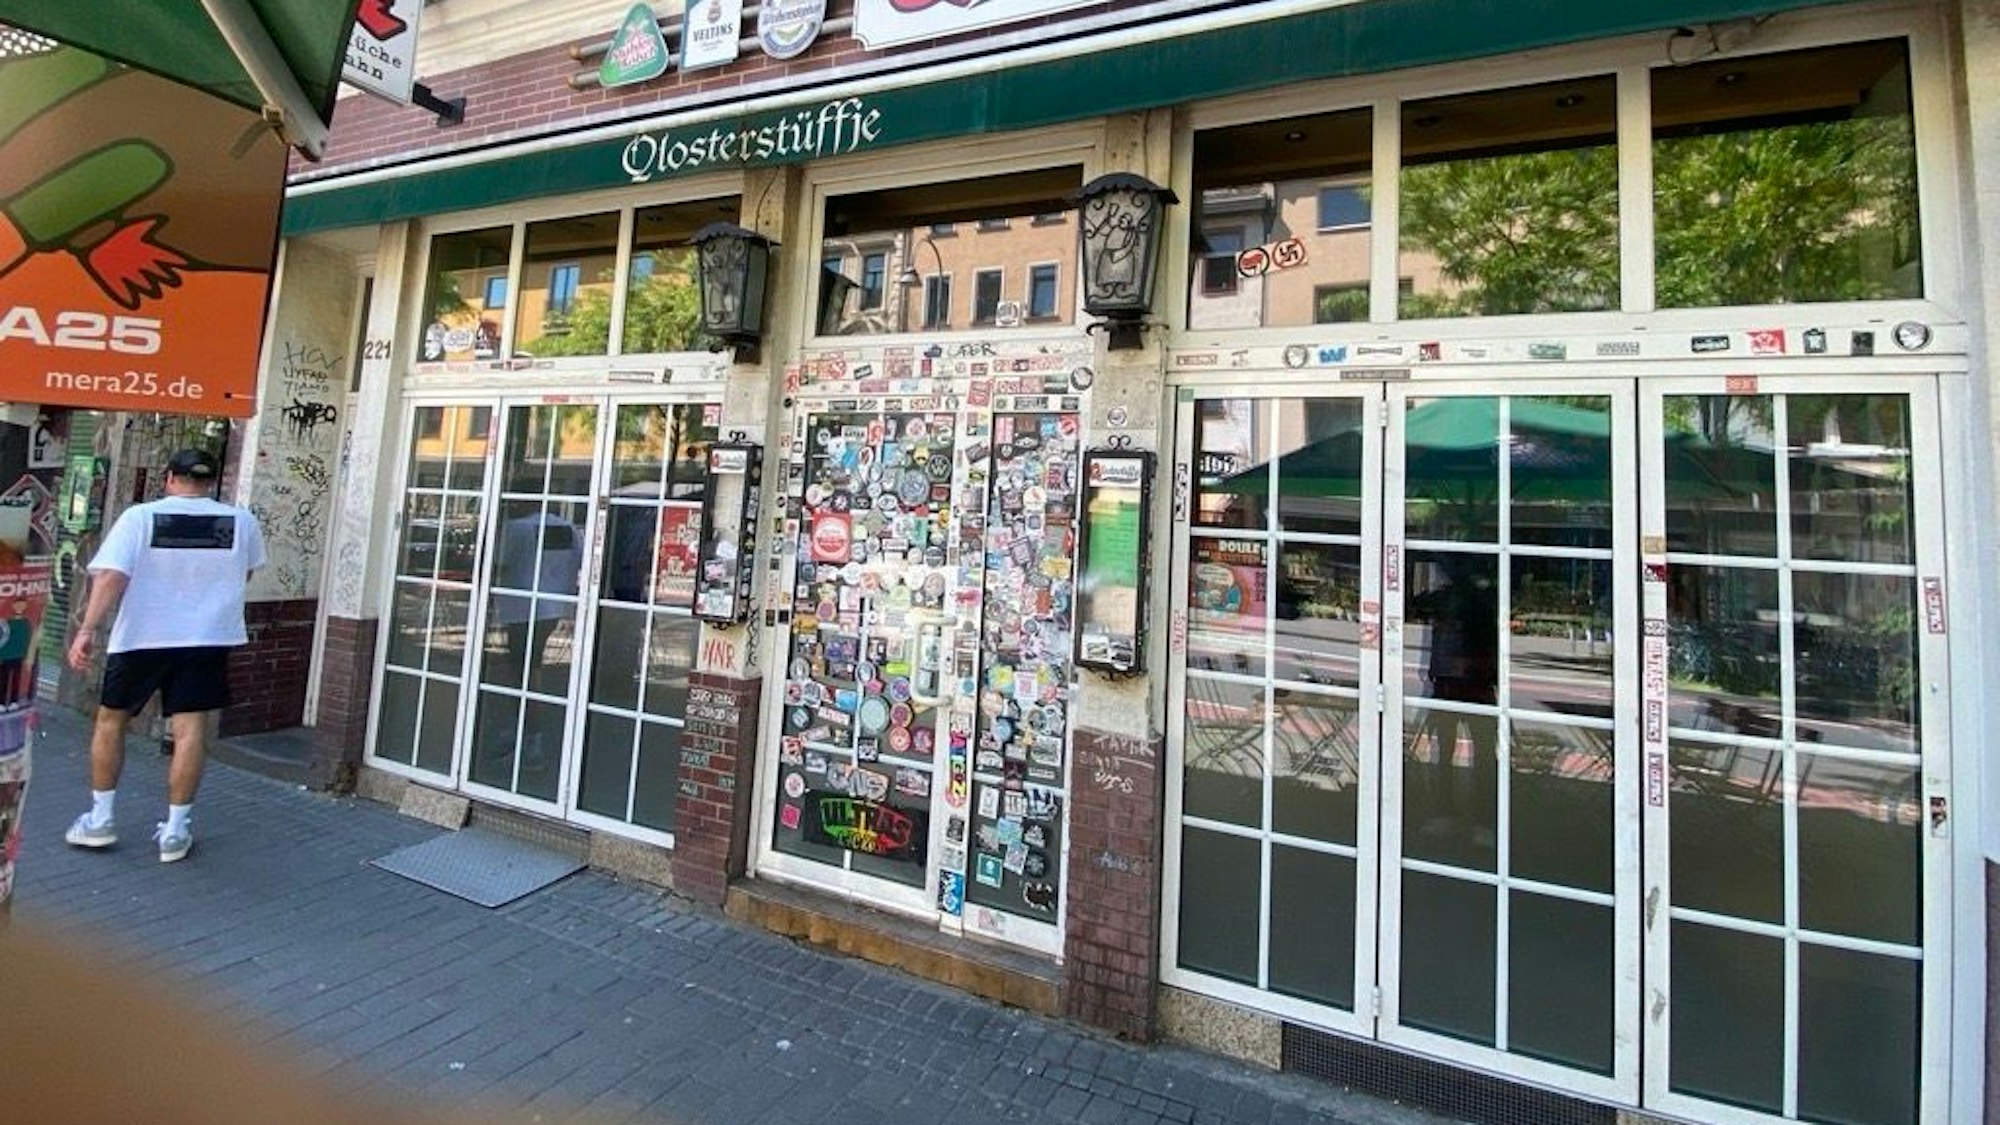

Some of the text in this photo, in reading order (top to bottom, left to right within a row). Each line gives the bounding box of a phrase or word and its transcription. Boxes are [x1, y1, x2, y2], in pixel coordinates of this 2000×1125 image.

[693, 23, 733, 42] VELTINS
[347, 35, 402, 69] üche
[365, 340, 391, 359] 221
[46, 371, 203, 399] mera25.de
